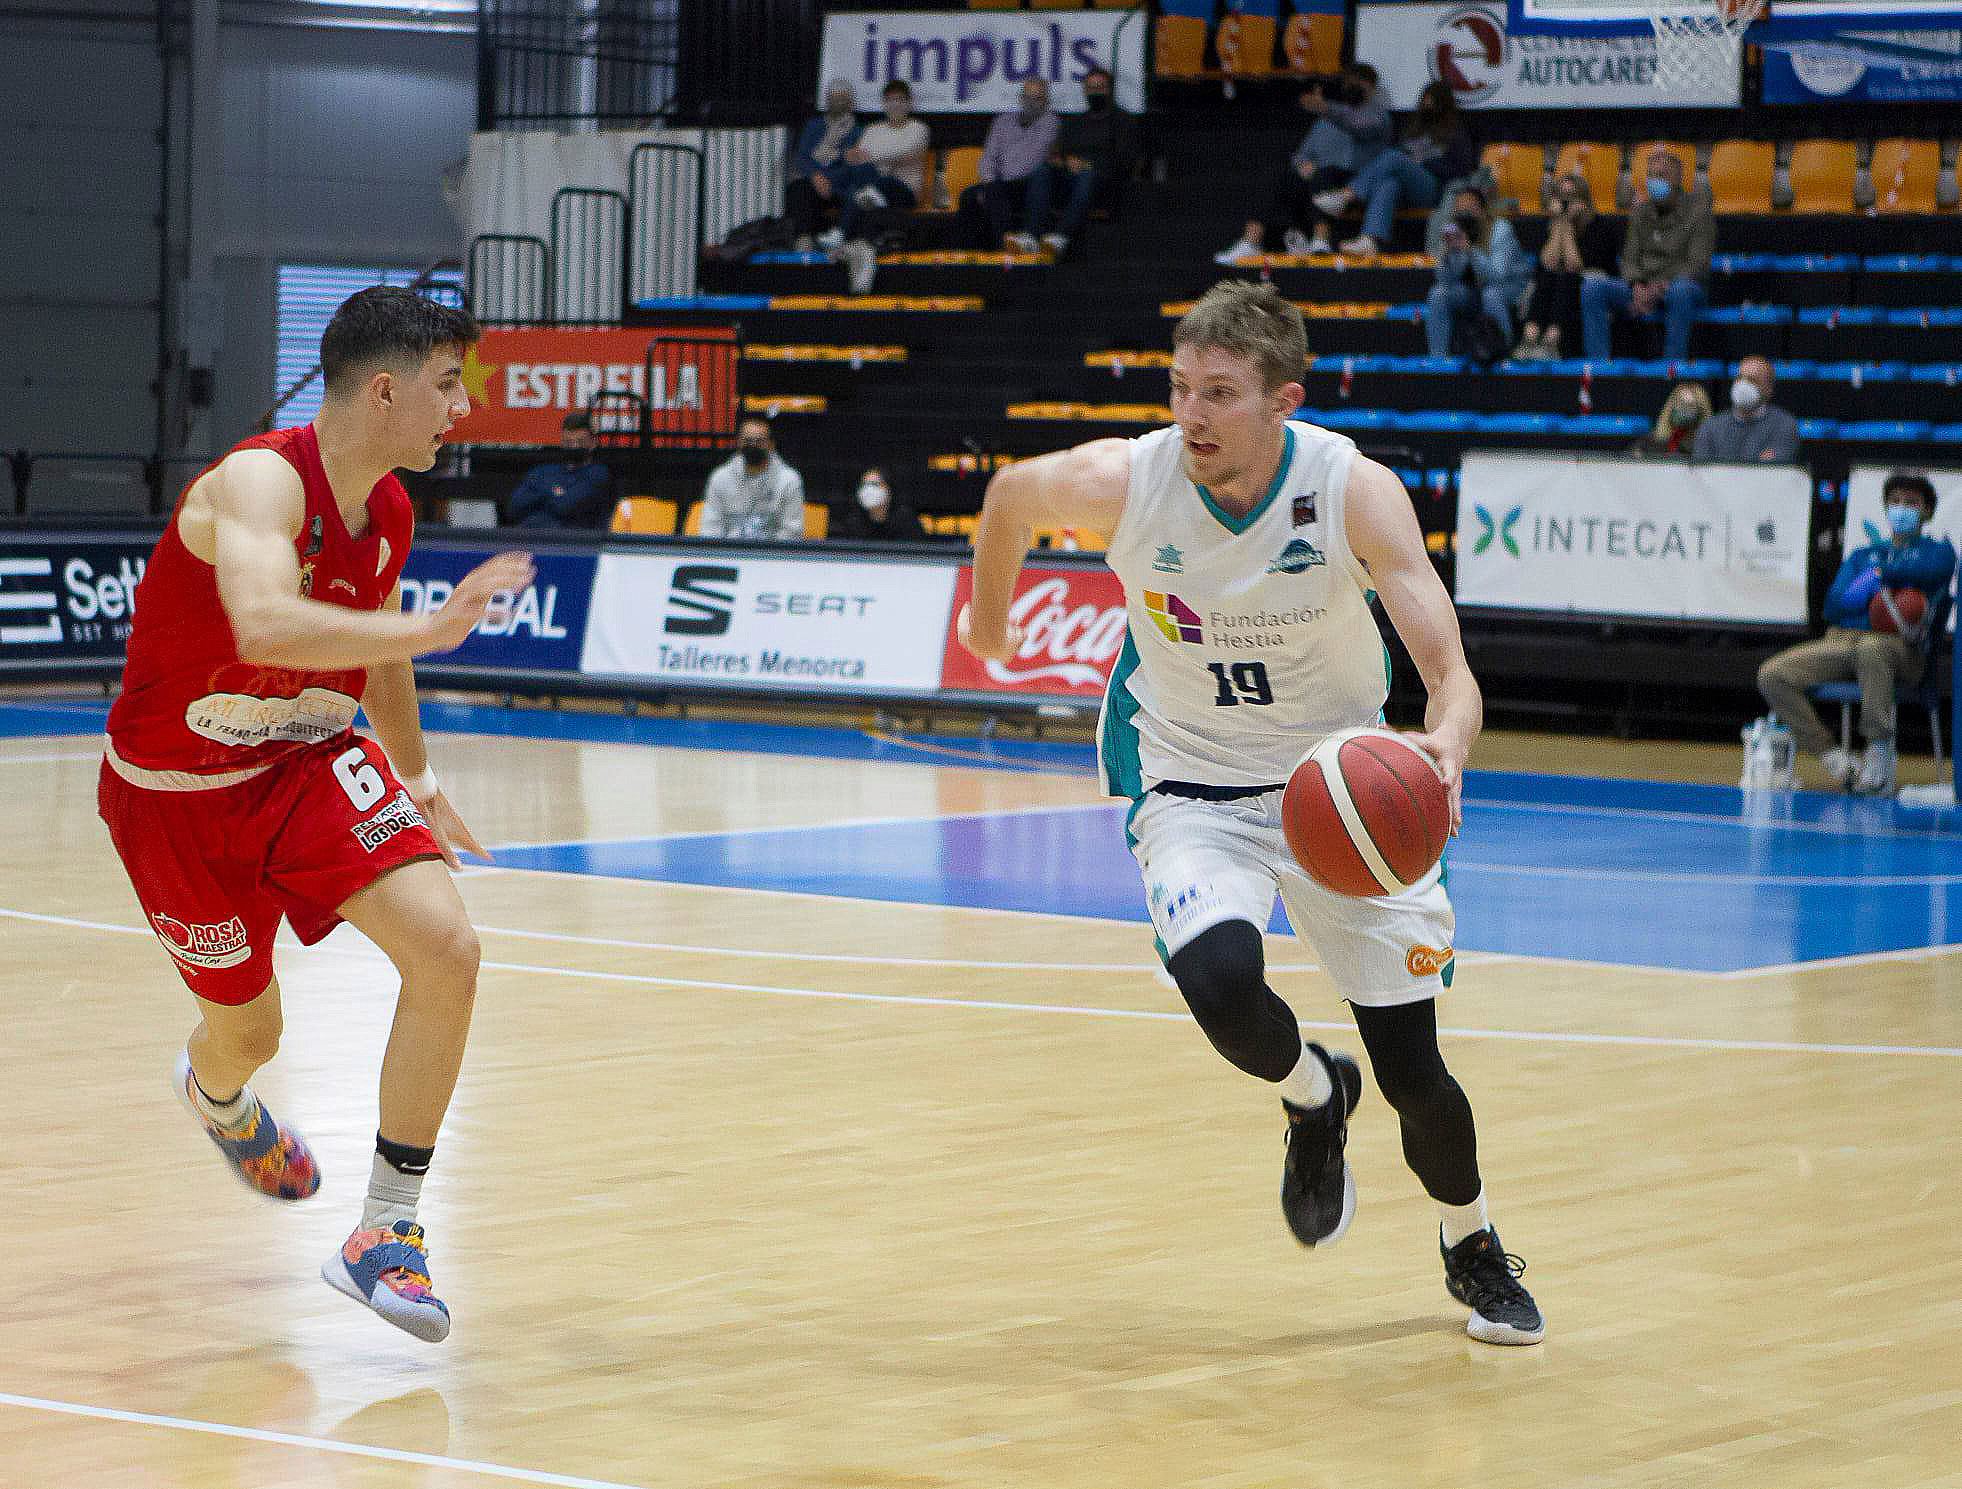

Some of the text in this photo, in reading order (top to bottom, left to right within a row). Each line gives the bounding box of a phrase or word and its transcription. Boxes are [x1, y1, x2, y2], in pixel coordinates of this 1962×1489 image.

[863, 24, 1099, 102] impuls
[1533, 512, 1712, 560] INTECAT
[755, 592, 876, 616] SEAT
[1213, 631, 1285, 650] Hestia
[659, 645, 866, 679] Talleres Menorca
[1207, 661, 1275, 707] 19
[332, 747, 386, 812] 6
[192, 918, 245, 944] ROSA
[198, 935, 246, 953] MAESTRAT
